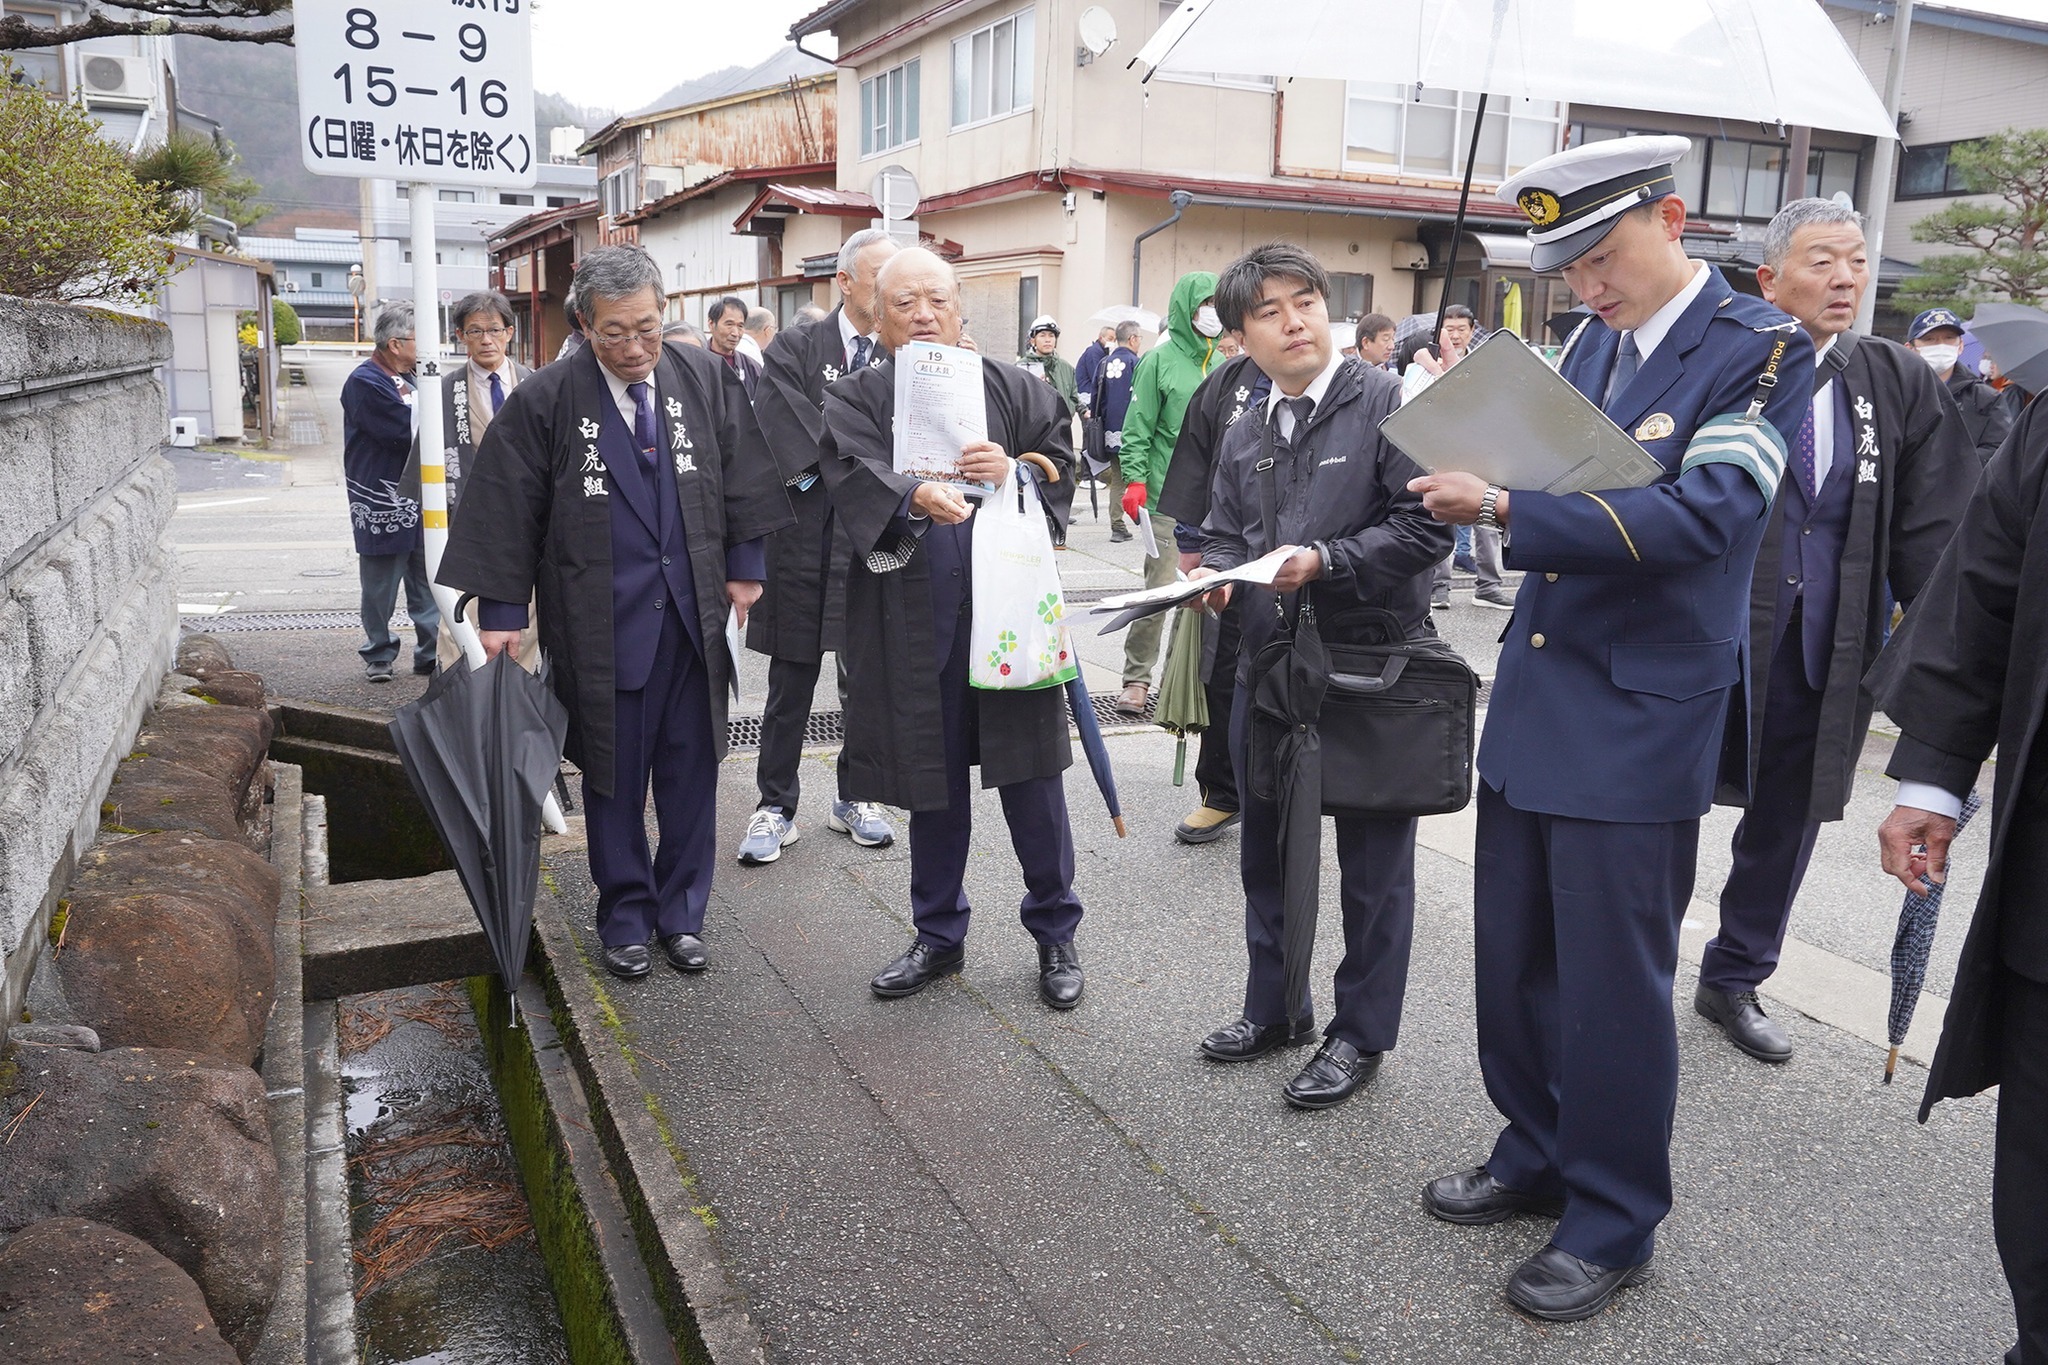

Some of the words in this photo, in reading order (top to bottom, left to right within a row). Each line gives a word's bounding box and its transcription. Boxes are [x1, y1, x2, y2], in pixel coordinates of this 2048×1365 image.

[308, 114, 531, 174] (日曜・休日を除く)
[928, 351, 943, 361] 19
[578, 417, 609, 497] 白虎組
[665, 396, 698, 474] 白虎組
[1854, 395, 1880, 484] 白虎組
